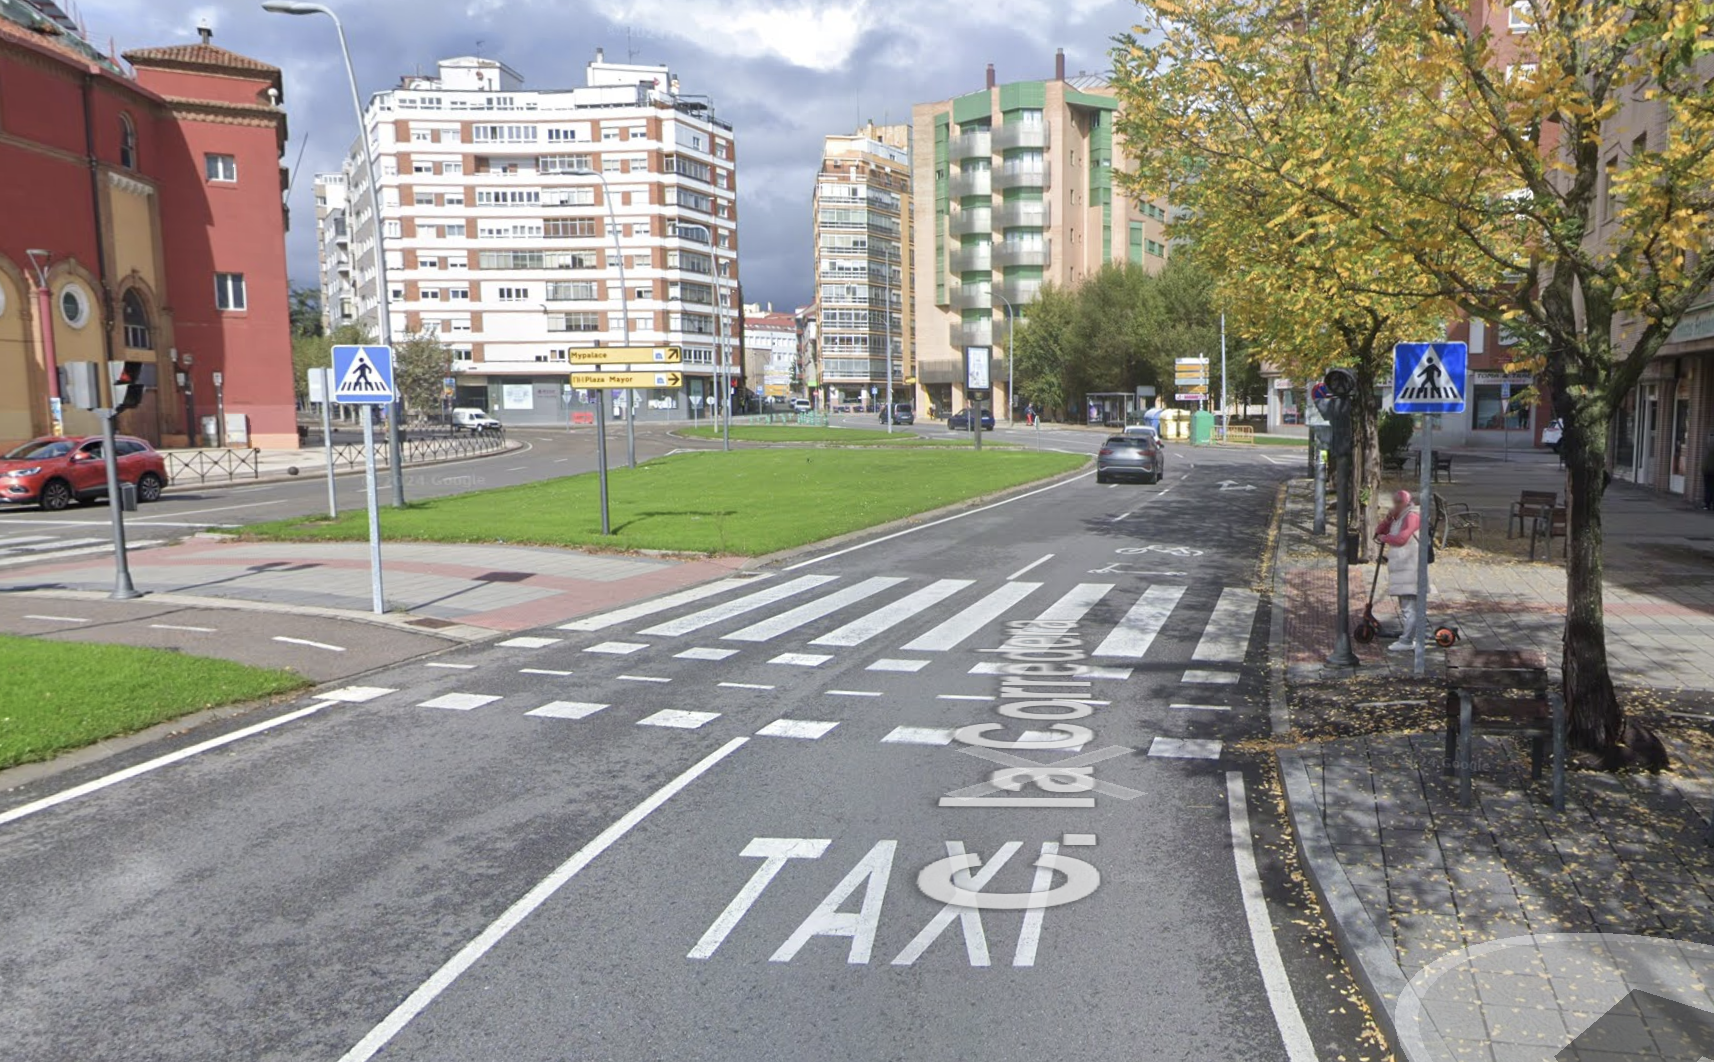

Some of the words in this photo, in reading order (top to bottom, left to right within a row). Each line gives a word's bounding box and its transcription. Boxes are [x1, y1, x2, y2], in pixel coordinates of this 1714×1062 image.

[571, 352, 607, 360] Mypalace
[585, 375, 605, 383] Plaza
[609, 375, 633, 385] Mayor
[686, 837, 1059, 967] TAXI
